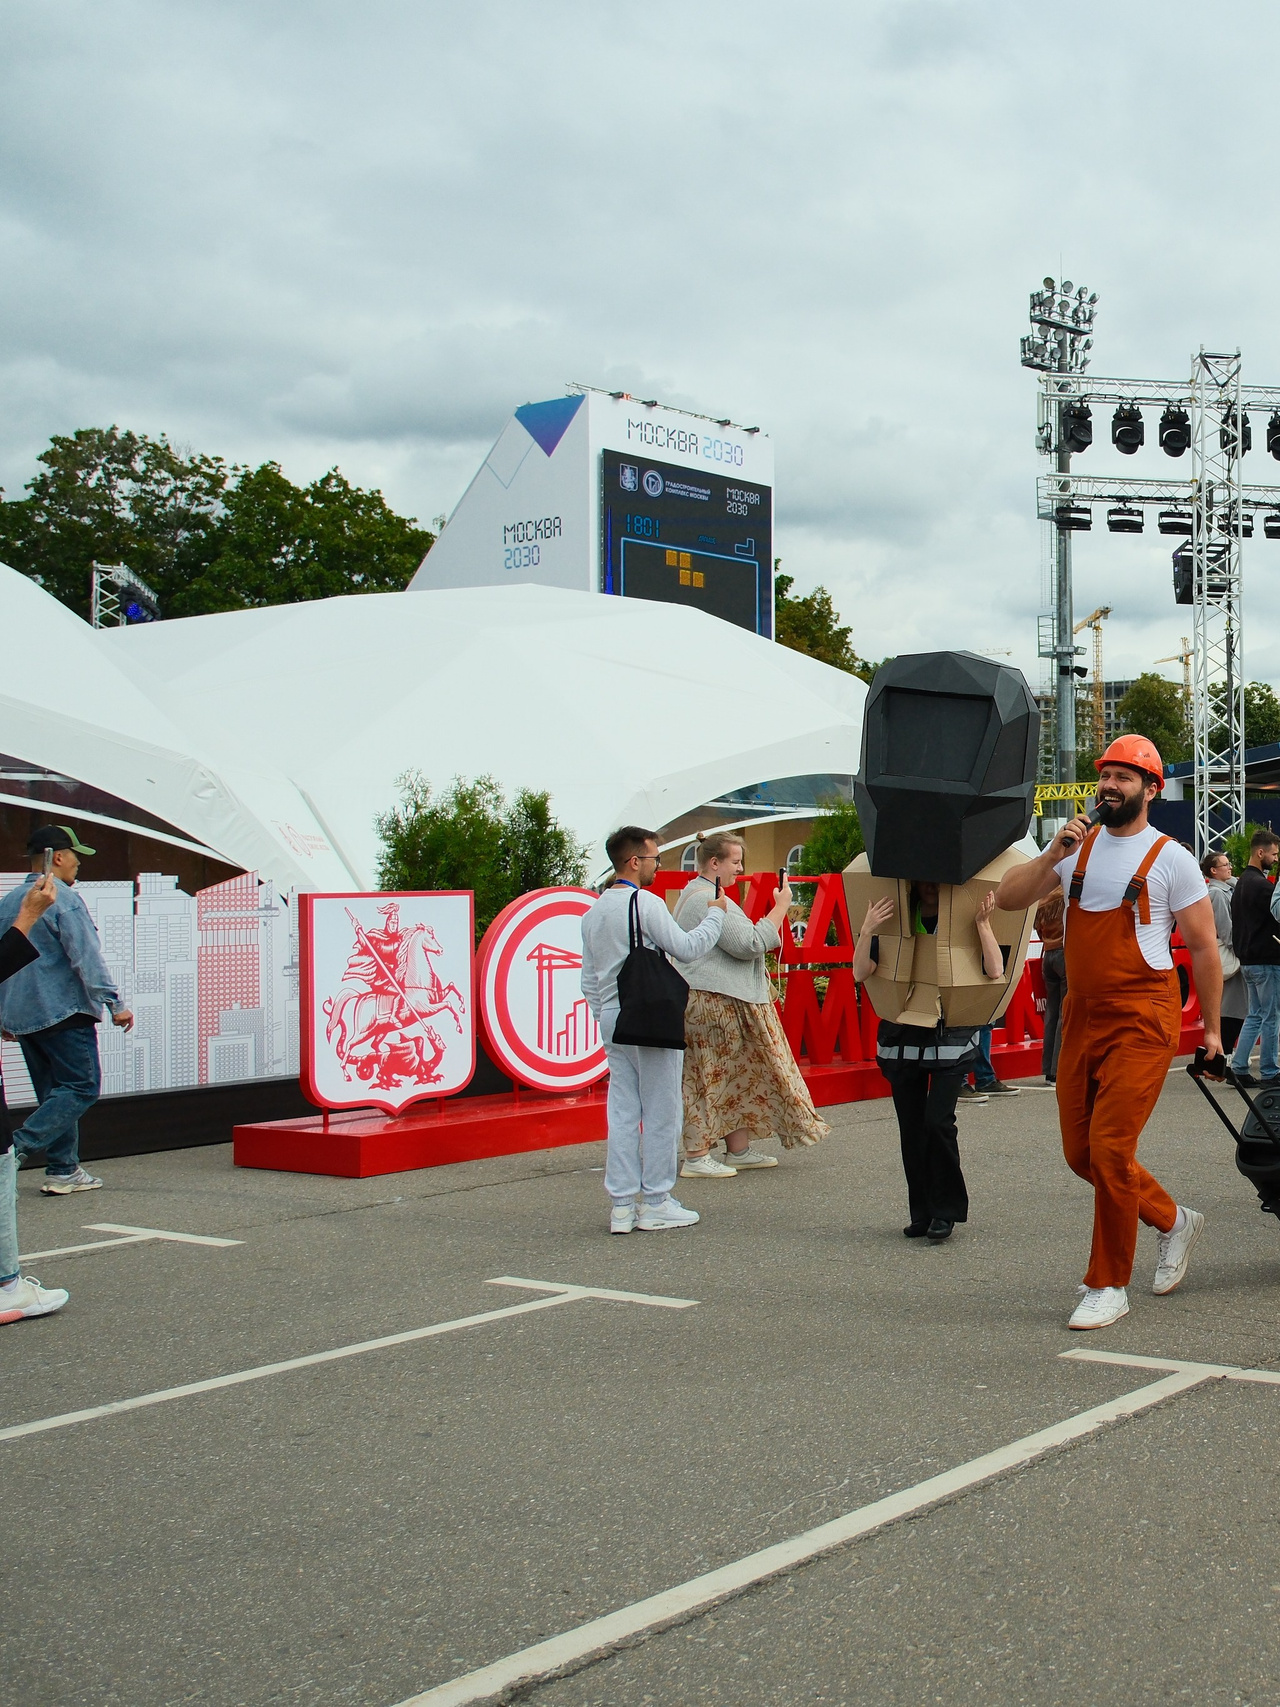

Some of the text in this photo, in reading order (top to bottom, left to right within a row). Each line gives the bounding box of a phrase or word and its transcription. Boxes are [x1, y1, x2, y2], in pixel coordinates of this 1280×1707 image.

[627, 418, 744, 467] МОСКВА 2030
[726, 487, 760, 505] МОСКВА
[726, 501, 748, 516] 2030
[503, 516, 562, 545] МОСКВА
[626, 513, 660, 538] 1801
[504, 544, 540, 570] 2030
